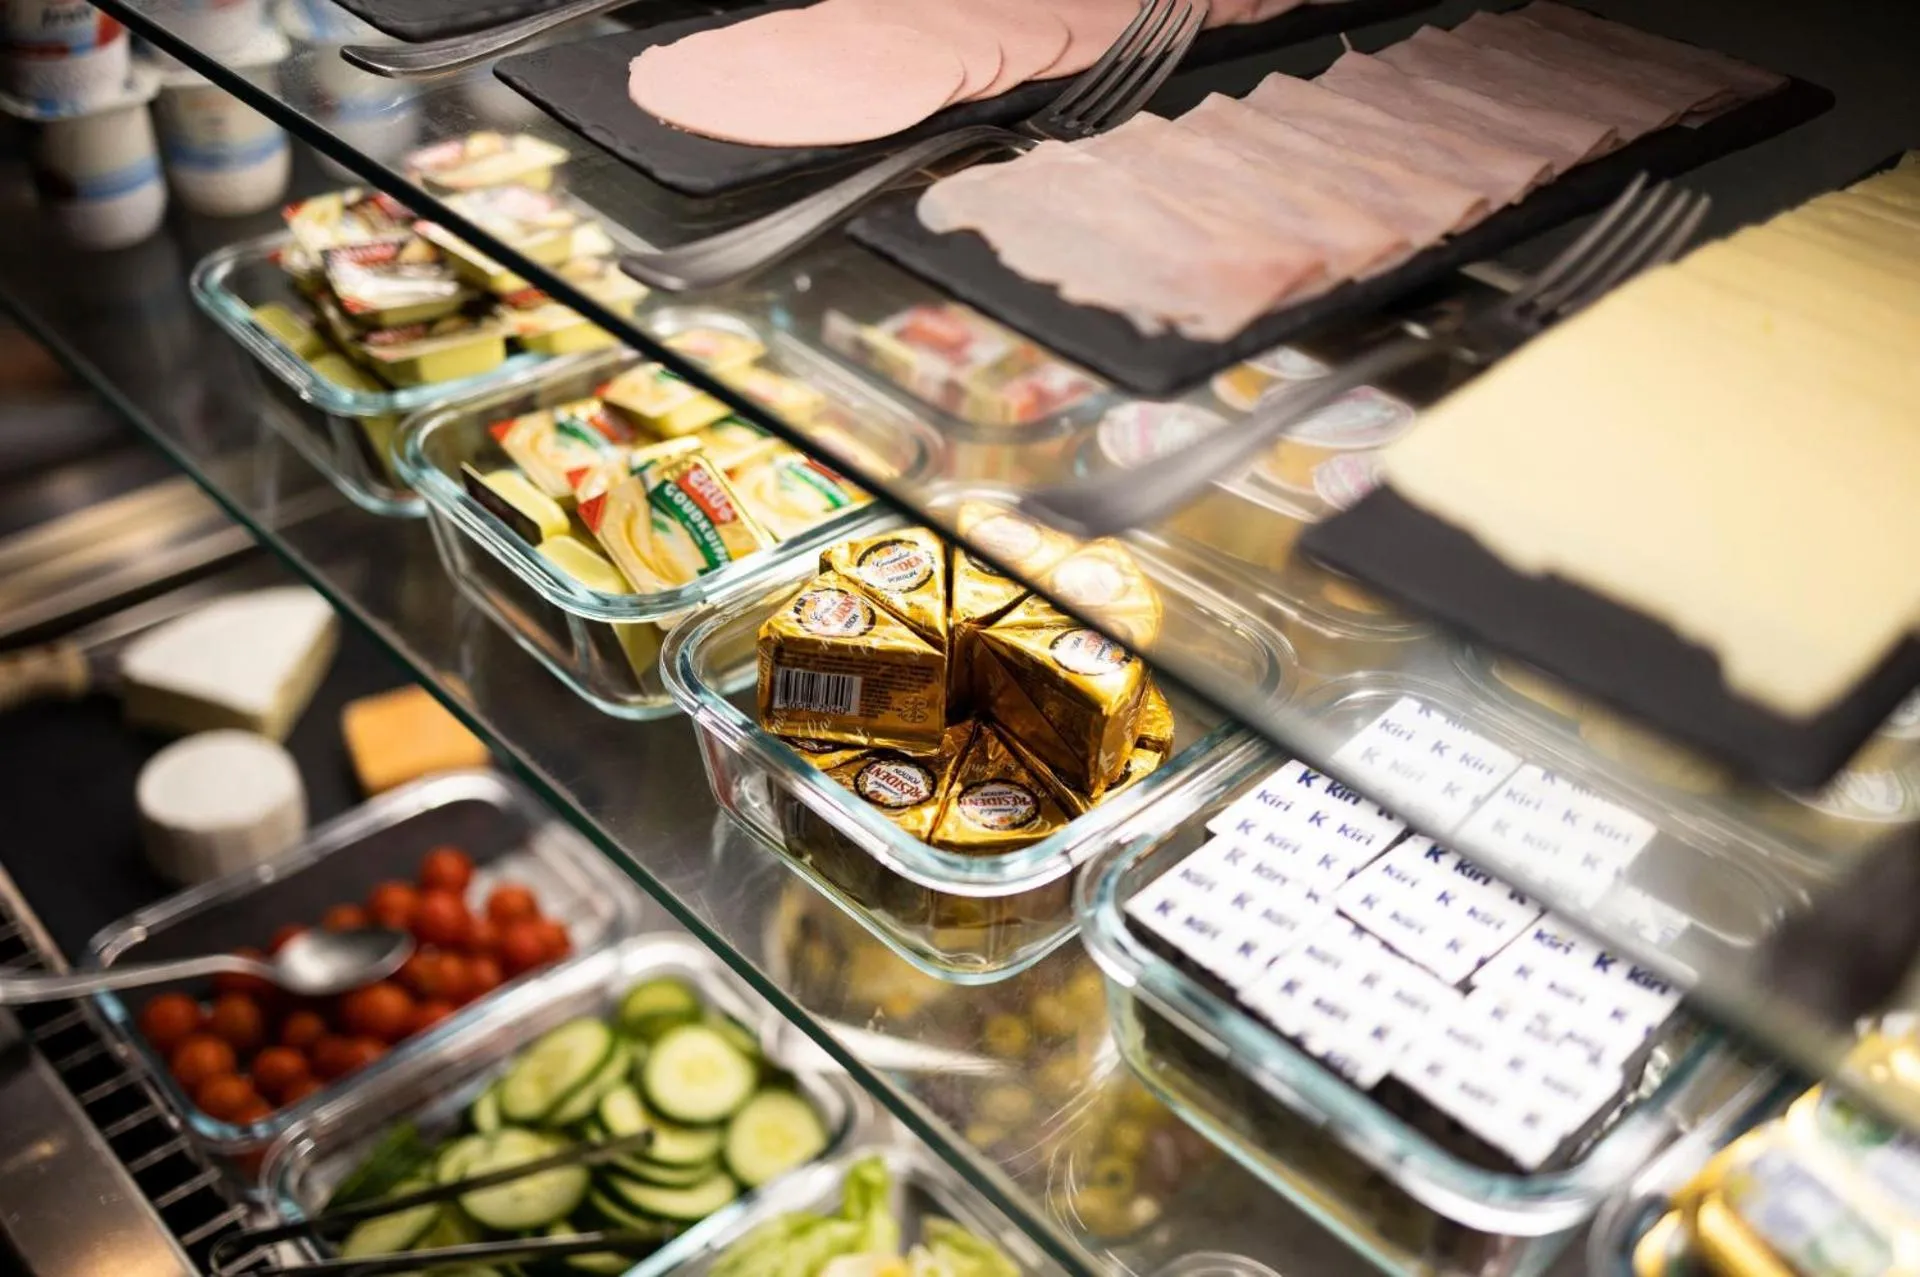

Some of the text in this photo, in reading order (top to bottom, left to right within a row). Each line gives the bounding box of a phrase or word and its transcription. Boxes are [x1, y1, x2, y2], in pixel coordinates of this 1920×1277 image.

[1379, 718, 1497, 775] Kiri K Kiri
[1296, 768, 1362, 806] K Kiri
[1256, 789, 1376, 846] Kiri K Kiri
[1505, 788, 1543, 811] Kiri
[1562, 808, 1582, 827] K
[1593, 821, 1633, 845] Kiri
[1235, 818, 1339, 870] K Kiri K
[1424, 842, 1493, 886] K Kiri
[1382, 864, 1420, 888] Kiri
[1436, 890, 1456, 907] K
[1593, 951, 1618, 973] K
[1626, 966, 1671, 996] Kiri
